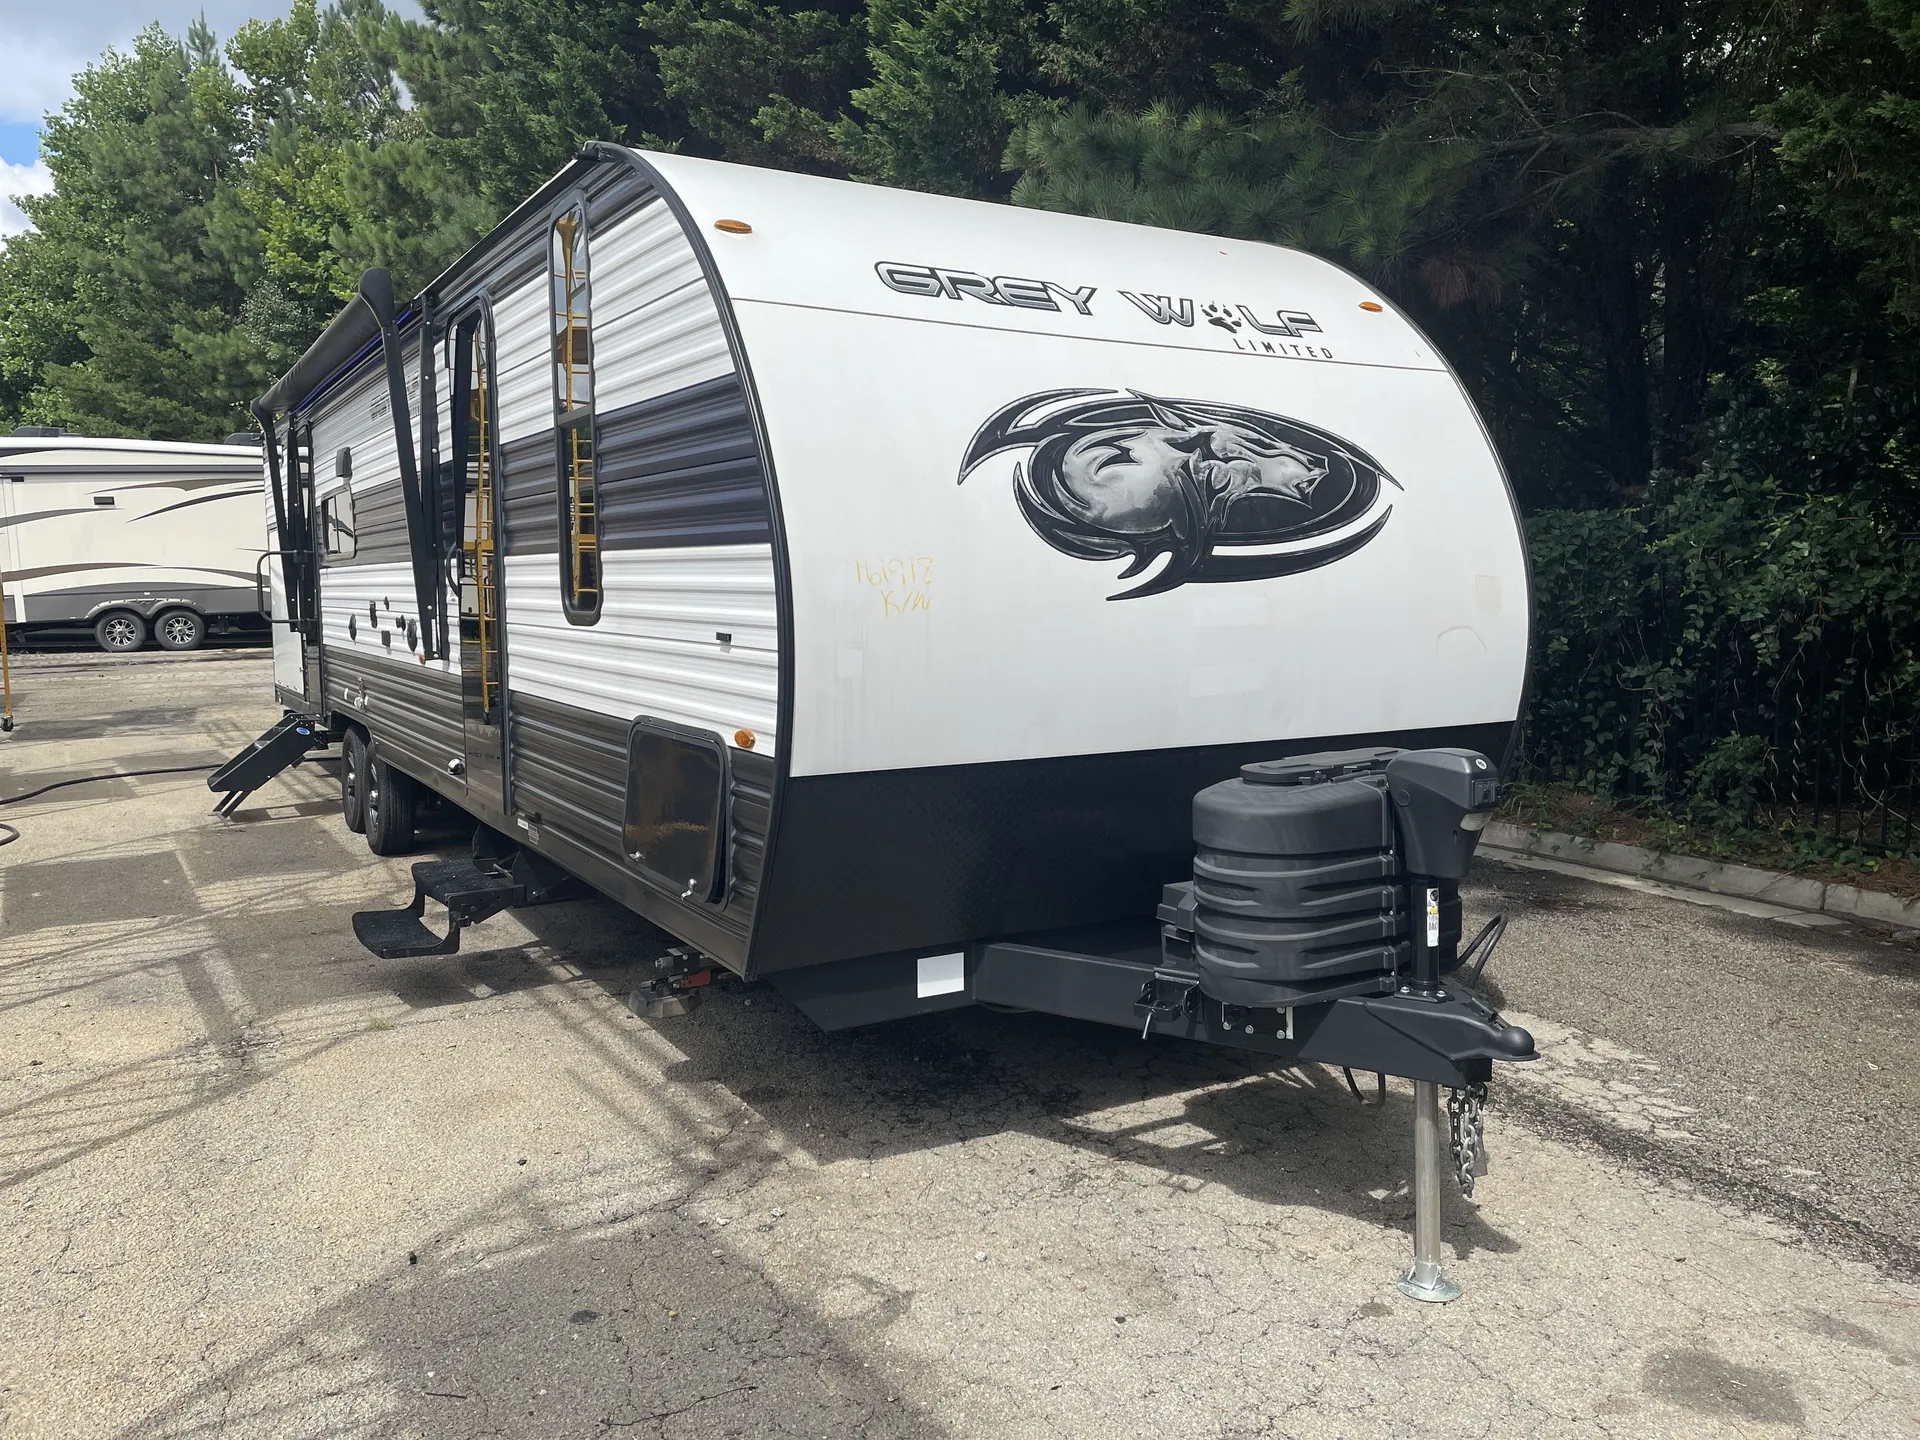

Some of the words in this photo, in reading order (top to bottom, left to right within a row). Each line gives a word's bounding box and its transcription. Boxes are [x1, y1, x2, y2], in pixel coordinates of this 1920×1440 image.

[874, 261, 1097, 316] GREY
[1117, 289, 1324, 338] WLF
[1233, 338, 1333, 359] LIMITED
